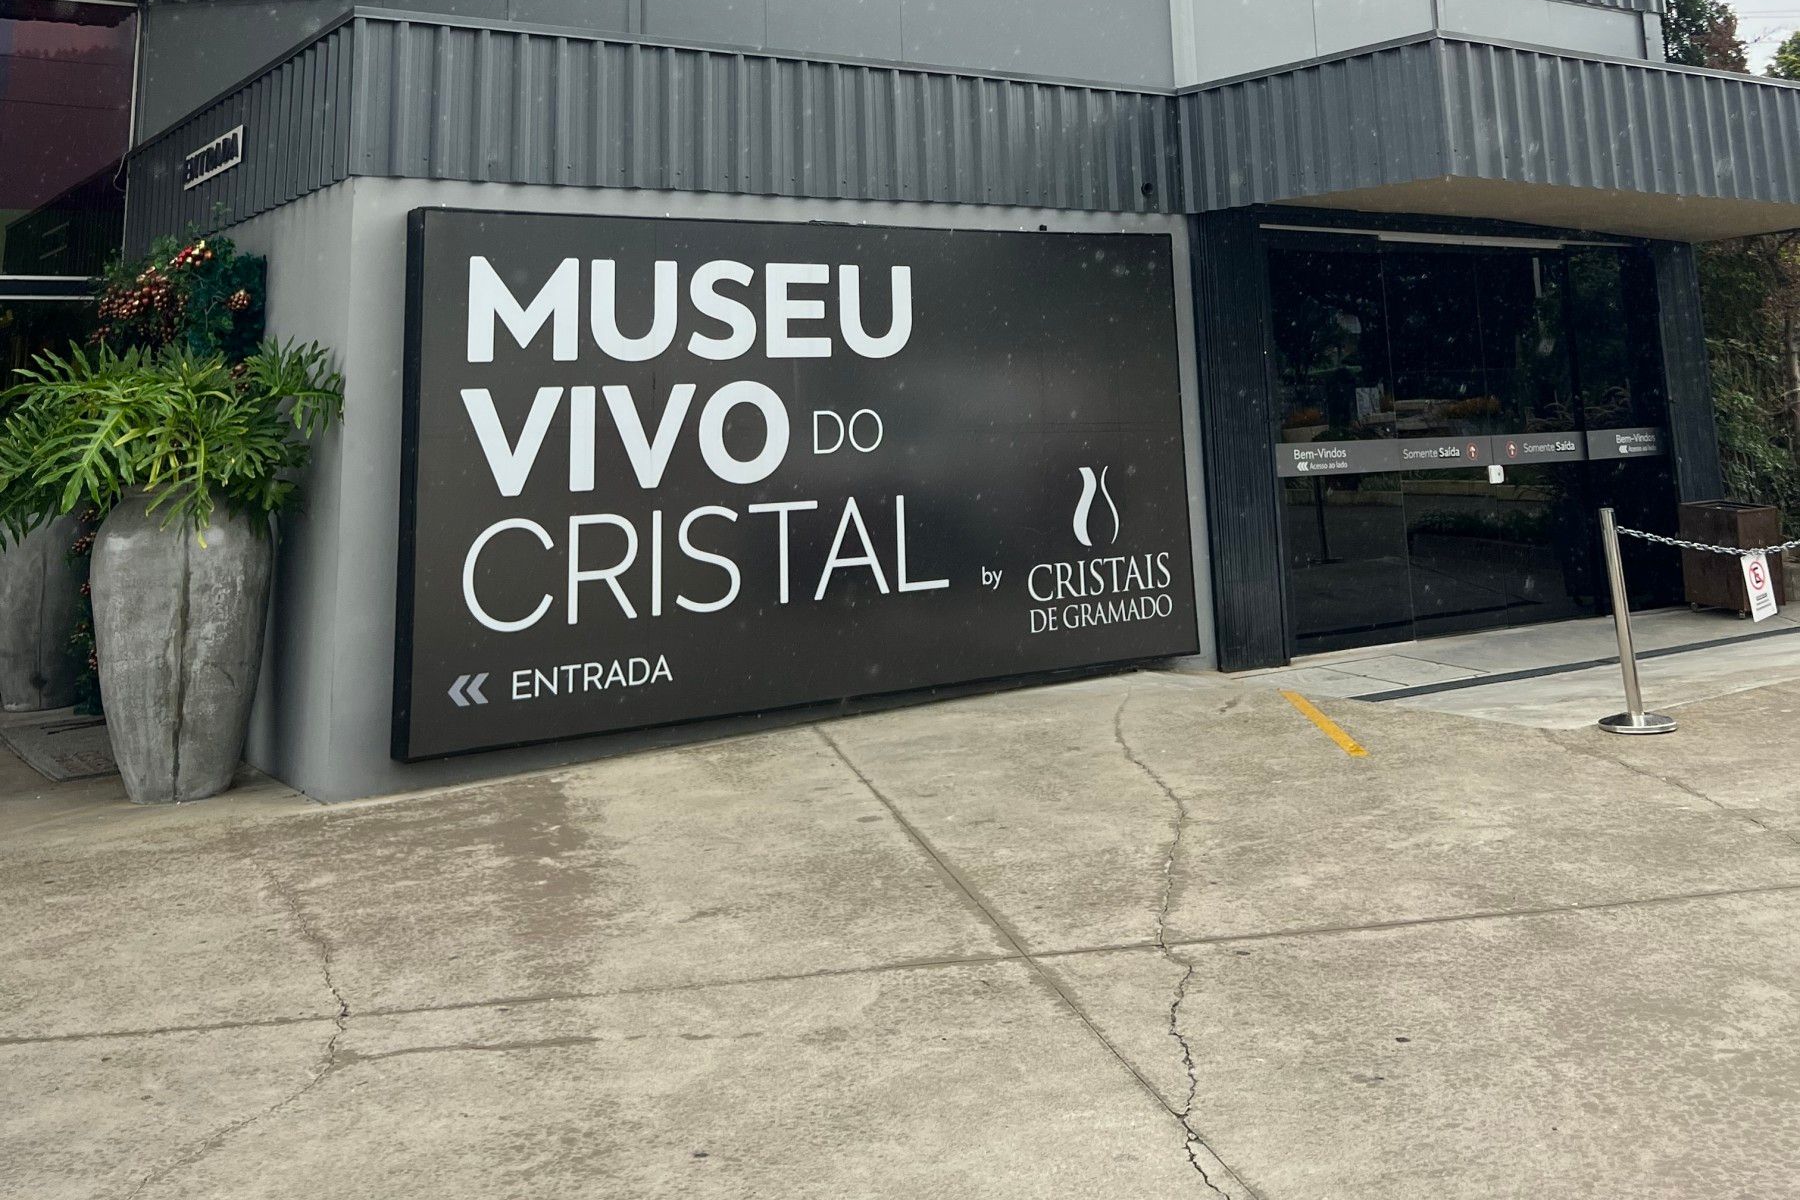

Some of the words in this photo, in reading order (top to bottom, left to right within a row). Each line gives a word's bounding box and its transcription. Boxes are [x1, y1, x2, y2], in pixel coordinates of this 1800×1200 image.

[466, 255, 913, 364] MUSEU
[459, 380, 791, 498] VIVO
[812, 408, 884, 455] DO
[1293, 446, 1347, 460] Bem-Vindos
[1403, 448, 1438, 460] Somente
[1438, 446, 1461, 458] Saída
[1523, 442, 1555, 454] Somente
[1555, 440, 1576, 452] Saída
[462, 494, 950, 633] CRISTAL
[981, 566, 1003, 590] by
[1027, 551, 1171, 602] CRISTAIS
[1029, 606, 1059, 634] DE
[1062, 593, 1173, 629] GRAMADO
[511, 654, 674, 701] ENTRADA
